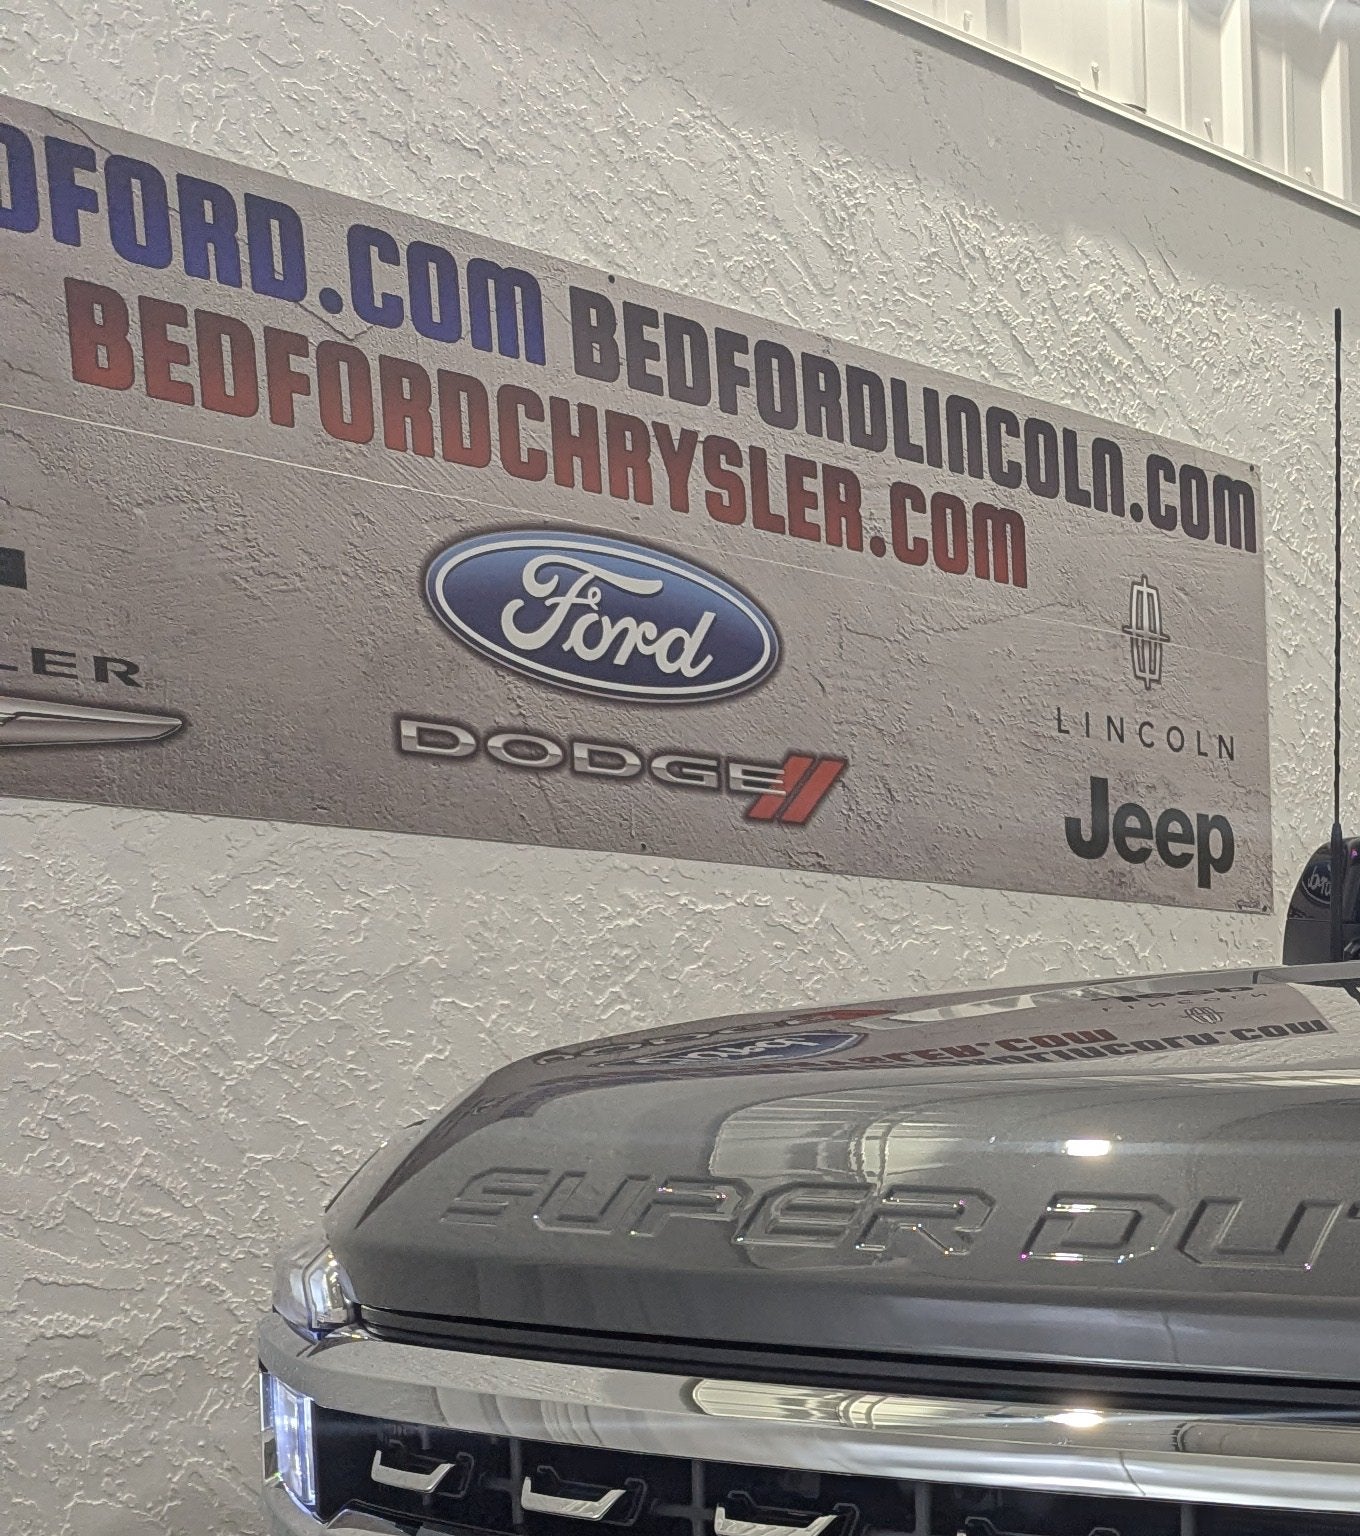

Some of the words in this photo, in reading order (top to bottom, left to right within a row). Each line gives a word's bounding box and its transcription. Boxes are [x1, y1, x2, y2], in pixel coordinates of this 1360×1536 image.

[63, 276, 1028, 589] BEDFORDCHRYSLER.COM
[568, 284, 1257, 554] BEDFORDLINCOLN.COM
[500, 554, 717, 680] Ford
[398, 717, 787, 796] DODGE
[1055, 706, 1236, 762] LINCOLN
[1063, 775, 1236, 890] Jeep
[439, 1166, 997, 1256] SUPER
